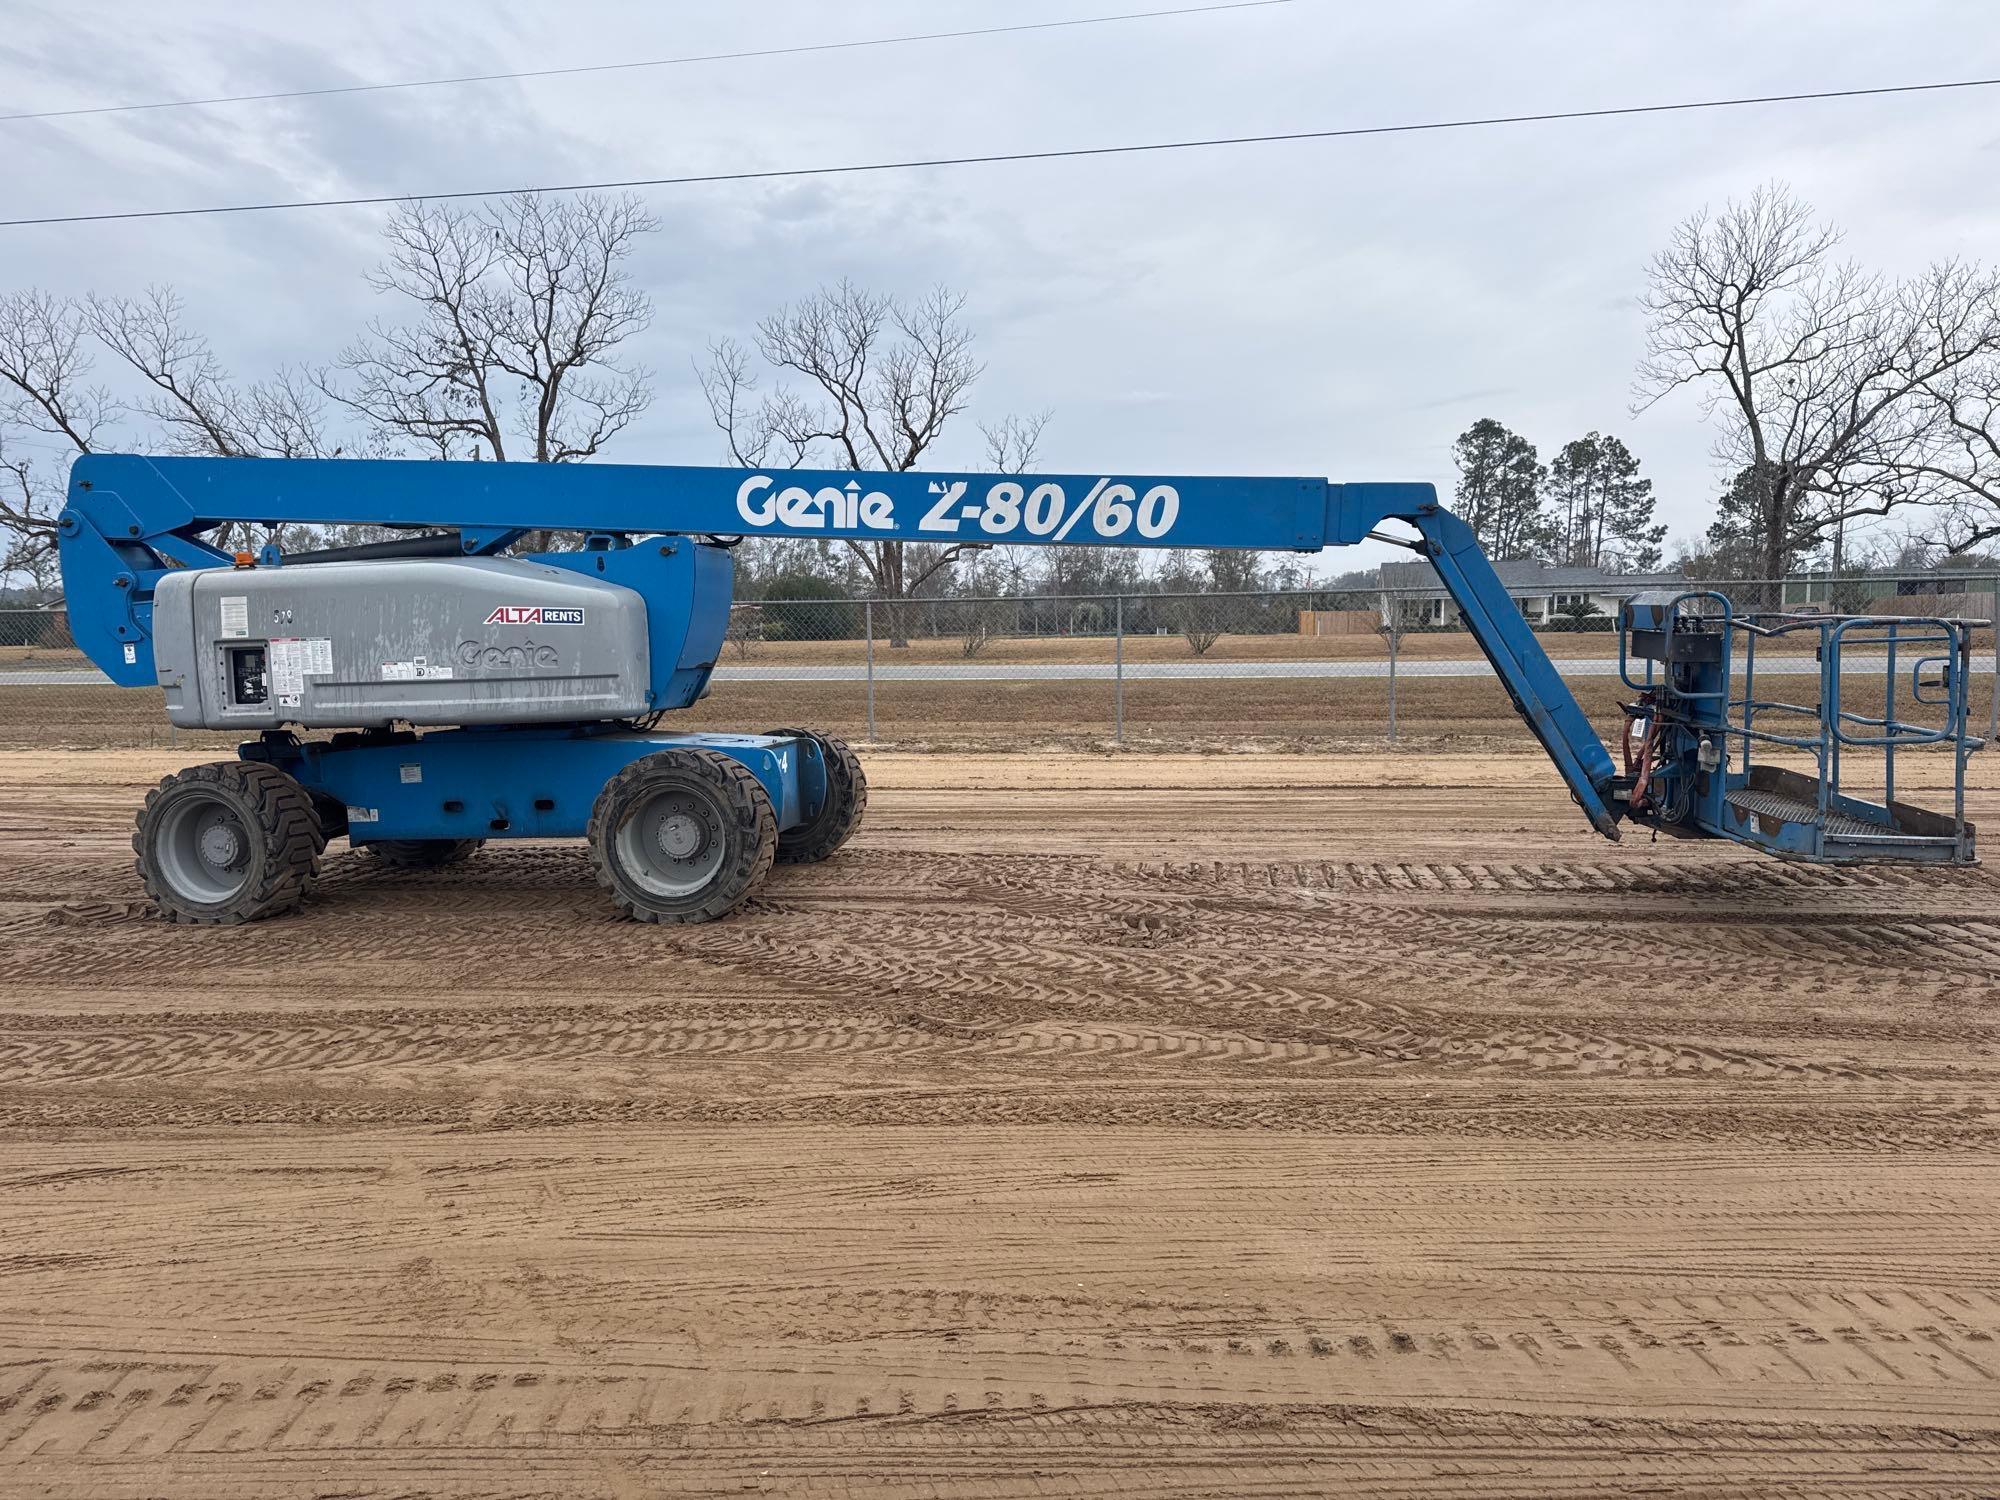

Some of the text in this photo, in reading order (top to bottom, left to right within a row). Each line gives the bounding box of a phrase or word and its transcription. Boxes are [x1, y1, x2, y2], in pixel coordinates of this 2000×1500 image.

[736, 475, 1180, 541] Genie Z-80/60
[486, 607, 581, 623] ALTA RENTS
[456, 640, 560, 670] Genie
